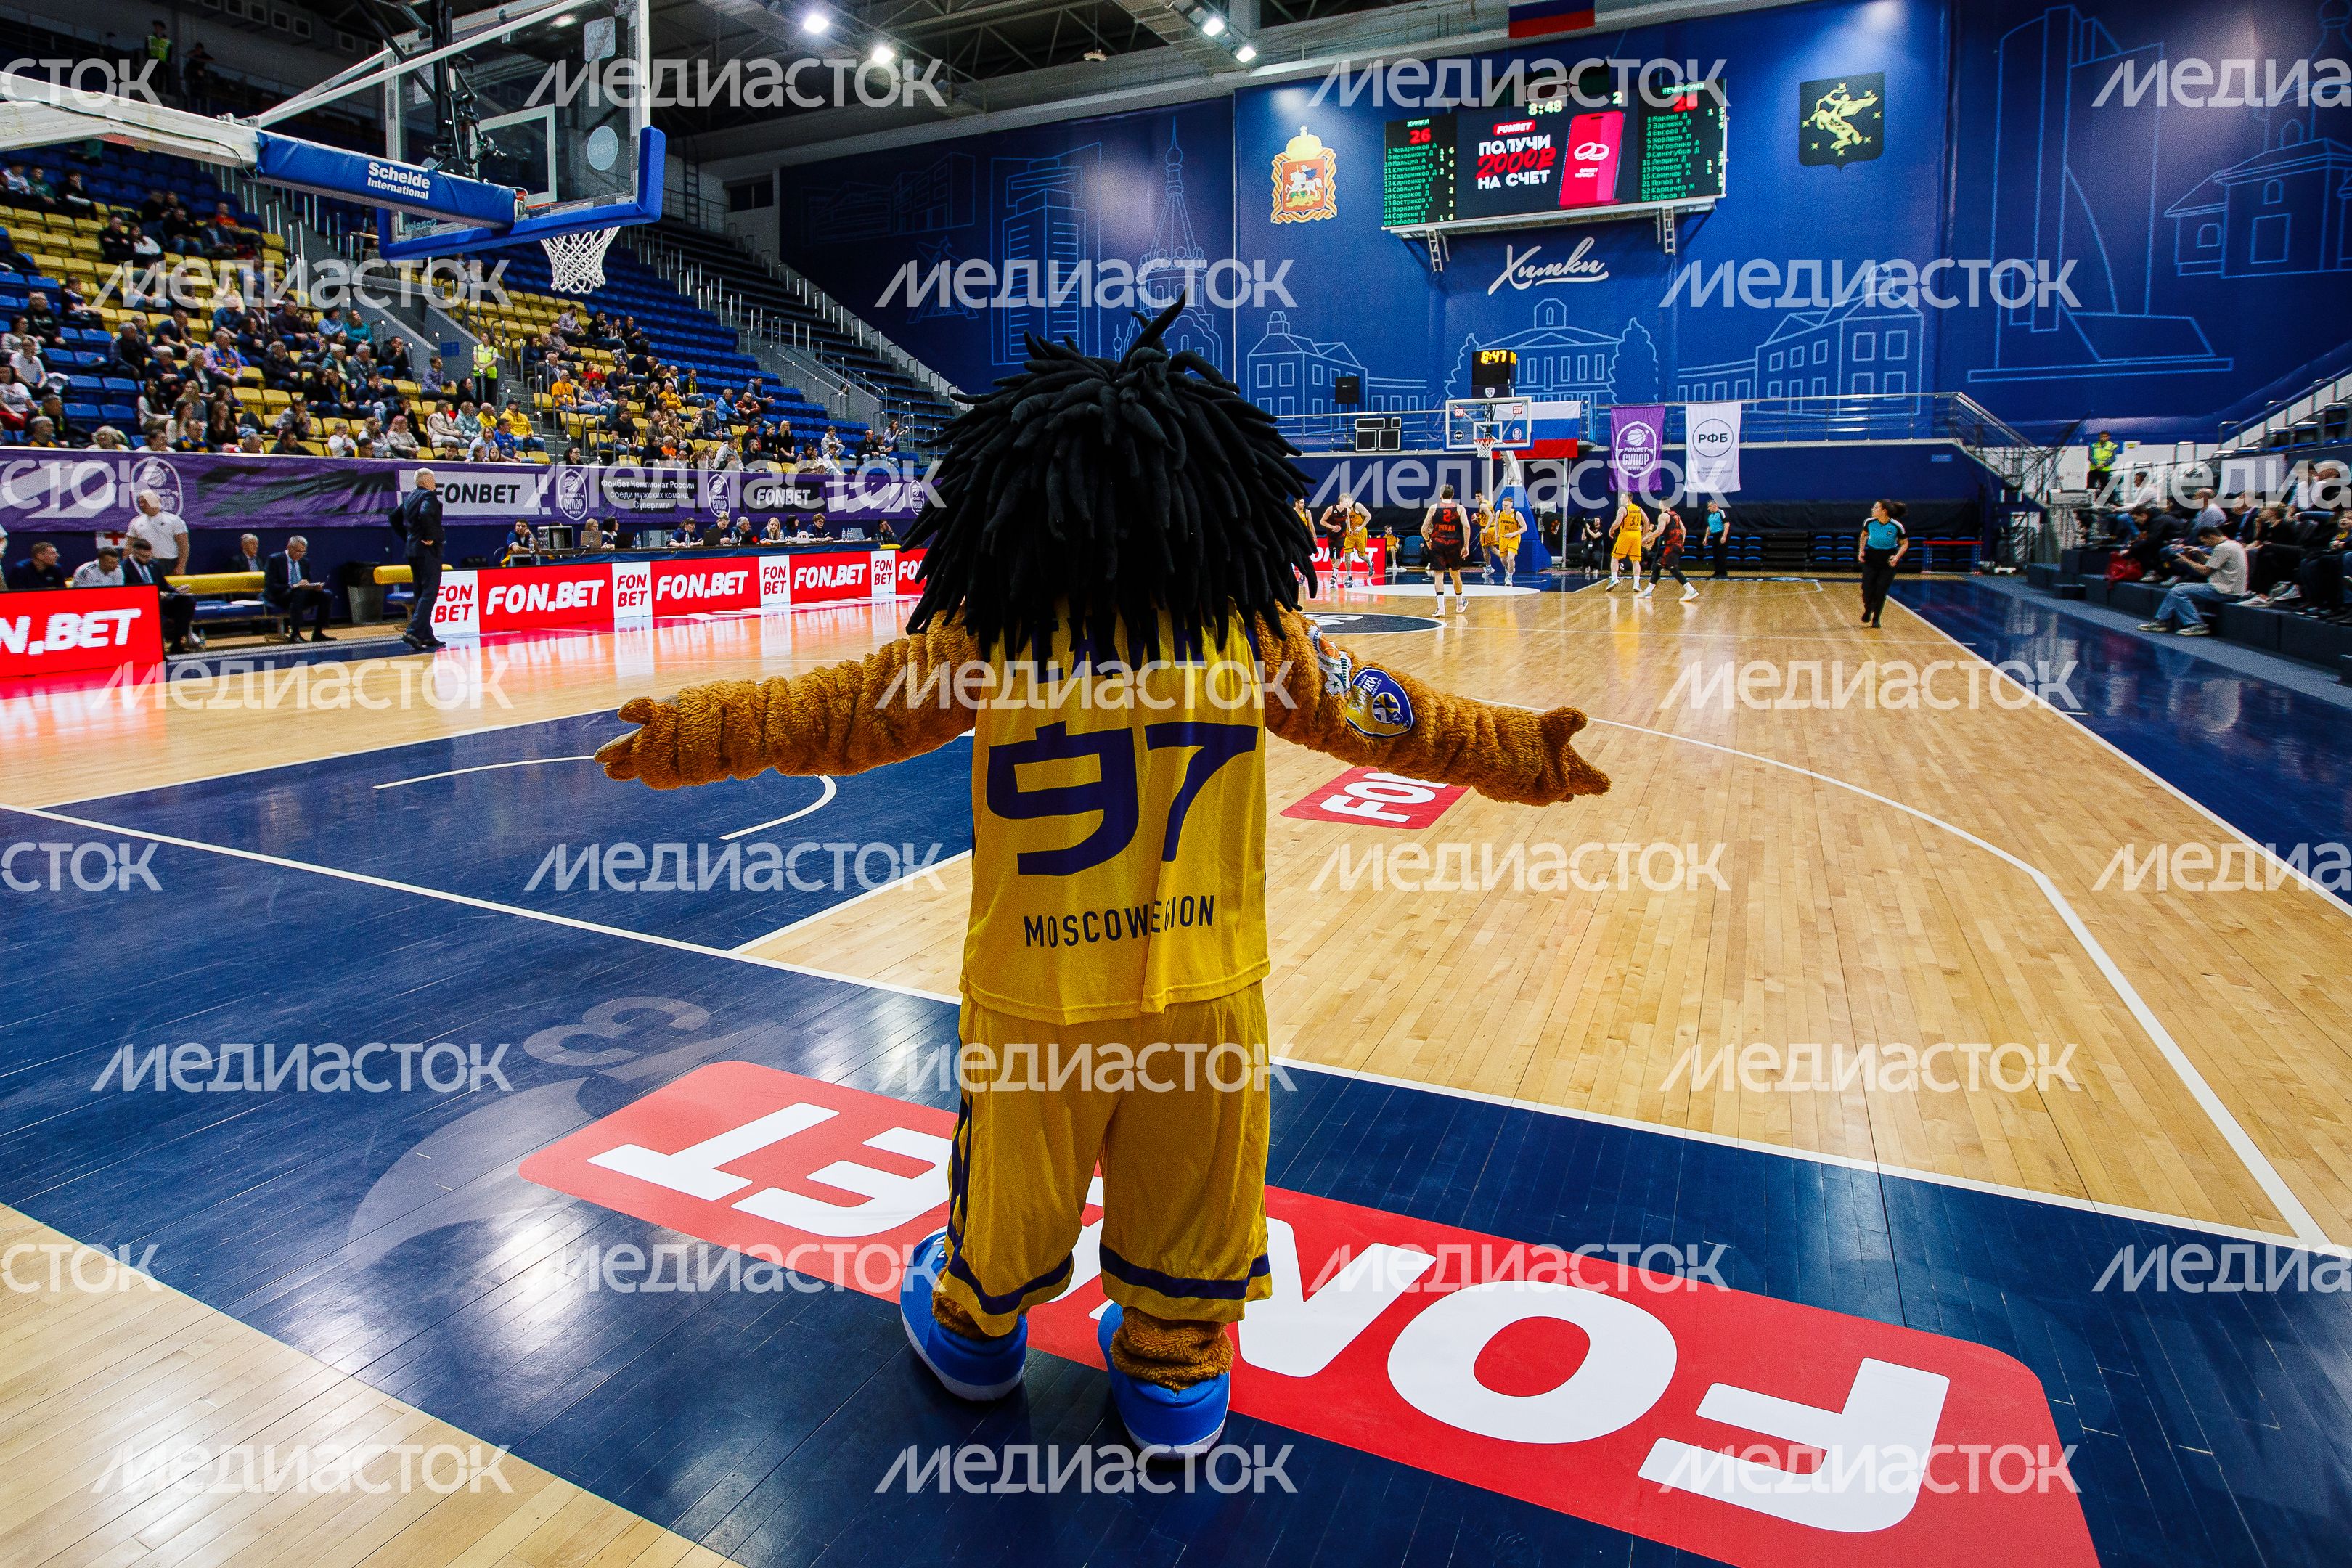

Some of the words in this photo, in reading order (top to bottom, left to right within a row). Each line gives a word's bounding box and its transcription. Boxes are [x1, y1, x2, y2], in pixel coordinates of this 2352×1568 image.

[1612, 91, 1623, 105] 2
[1527, 99, 1563, 116] 8:48
[1406, 118, 1430, 128] ХИМКИ
[1409, 128, 1432, 144] 26
[1478, 134, 1551, 157] ПОЛУЧИ
[368, 161, 430, 189] Schelde
[1477, 175, 1502, 190] НА
[1505, 169, 1551, 187] СЧЕТ
[367, 176, 429, 200] International
[1489, 237, 1609, 295] Химки
[1481, 350, 1507, 364] 8:47
[1698, 433, 1728, 444] РФБ
[601, 479, 629, 489] Фонбет
[631, 481, 669, 491] Чемпионат
[436, 483, 520, 504] FONBET
[665, 492, 690, 501] команд
[756, 489, 811, 505] FONBET
[633, 500, 670, 510] Суперлиги
[1442, 509, 1451, 522] 2
[763, 566, 786, 579] FON
[873, 560, 893, 572] FON
[616, 573, 646, 589] FON
[794, 563, 866, 589] FON.BET
[874, 571, 892, 585] BET
[436, 585, 473, 602] FON
[656, 571, 748, 601] FON.BET
[764, 579, 786, 595] BET
[486, 579, 604, 615] FON.BET
[618, 590, 648, 607] BET
[434, 603, 473, 623] BET
[986, 720, 1259, 876] 97
[1024, 902, 1149, 949] MOSCOW
